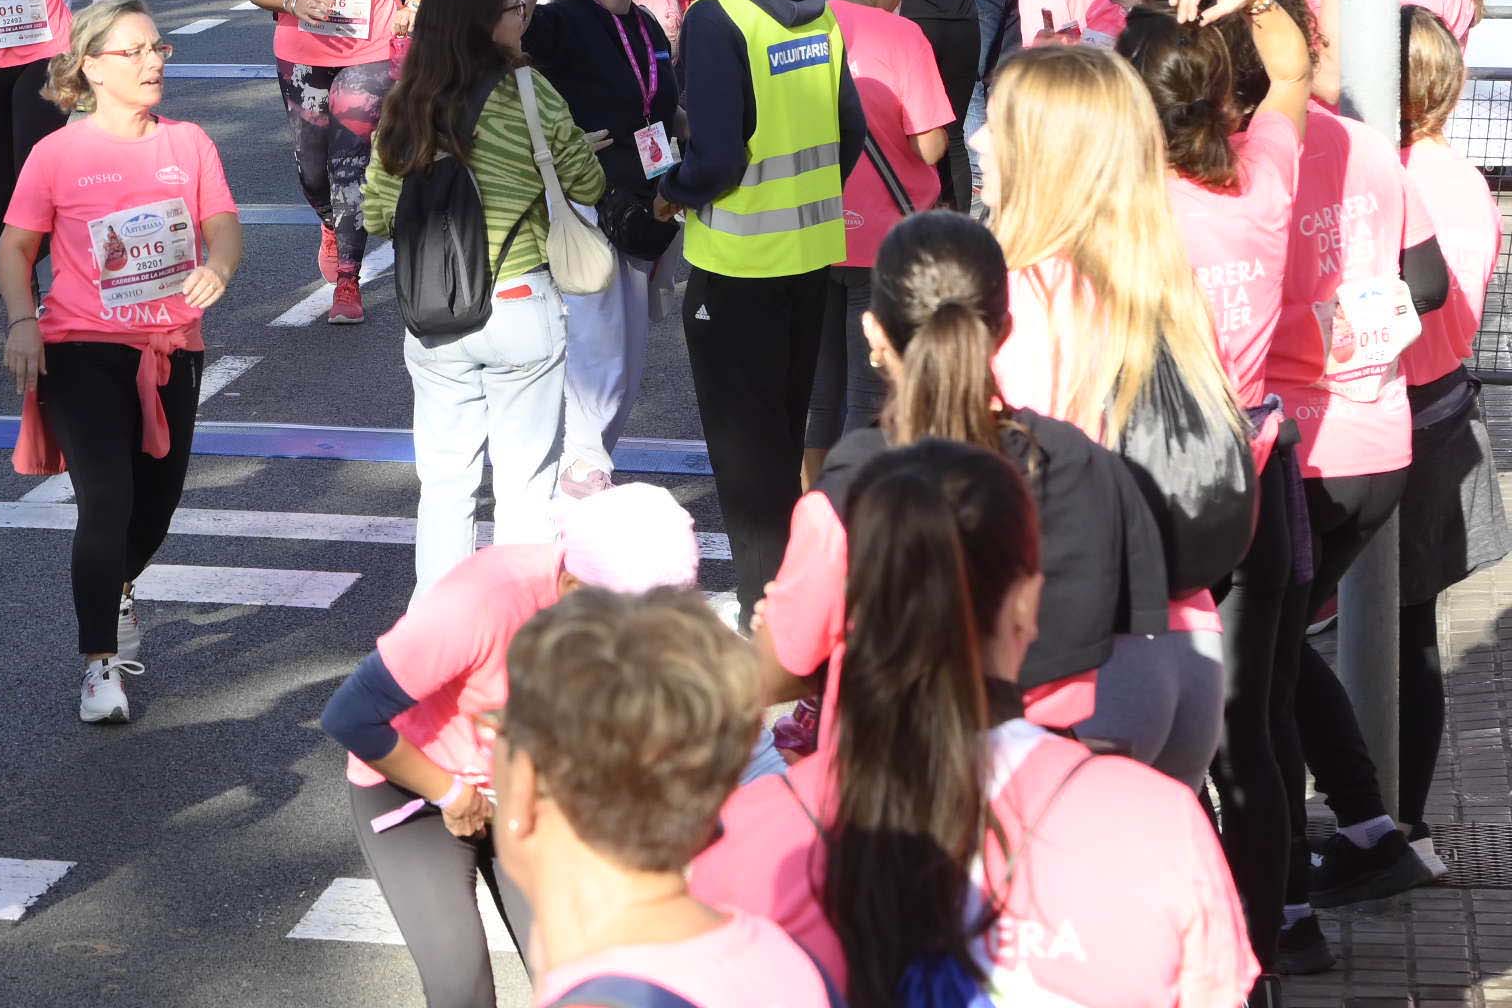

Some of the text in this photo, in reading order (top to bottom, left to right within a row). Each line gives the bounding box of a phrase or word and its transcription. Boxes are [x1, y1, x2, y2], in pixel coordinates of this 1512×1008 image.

[769, 41, 829, 69] VOLUNTARIS
[77, 172, 123, 188] OYSHO
[130, 240, 165, 259] 016
[136, 259, 164, 272] 28201
[1359, 326, 1390, 347] 016
